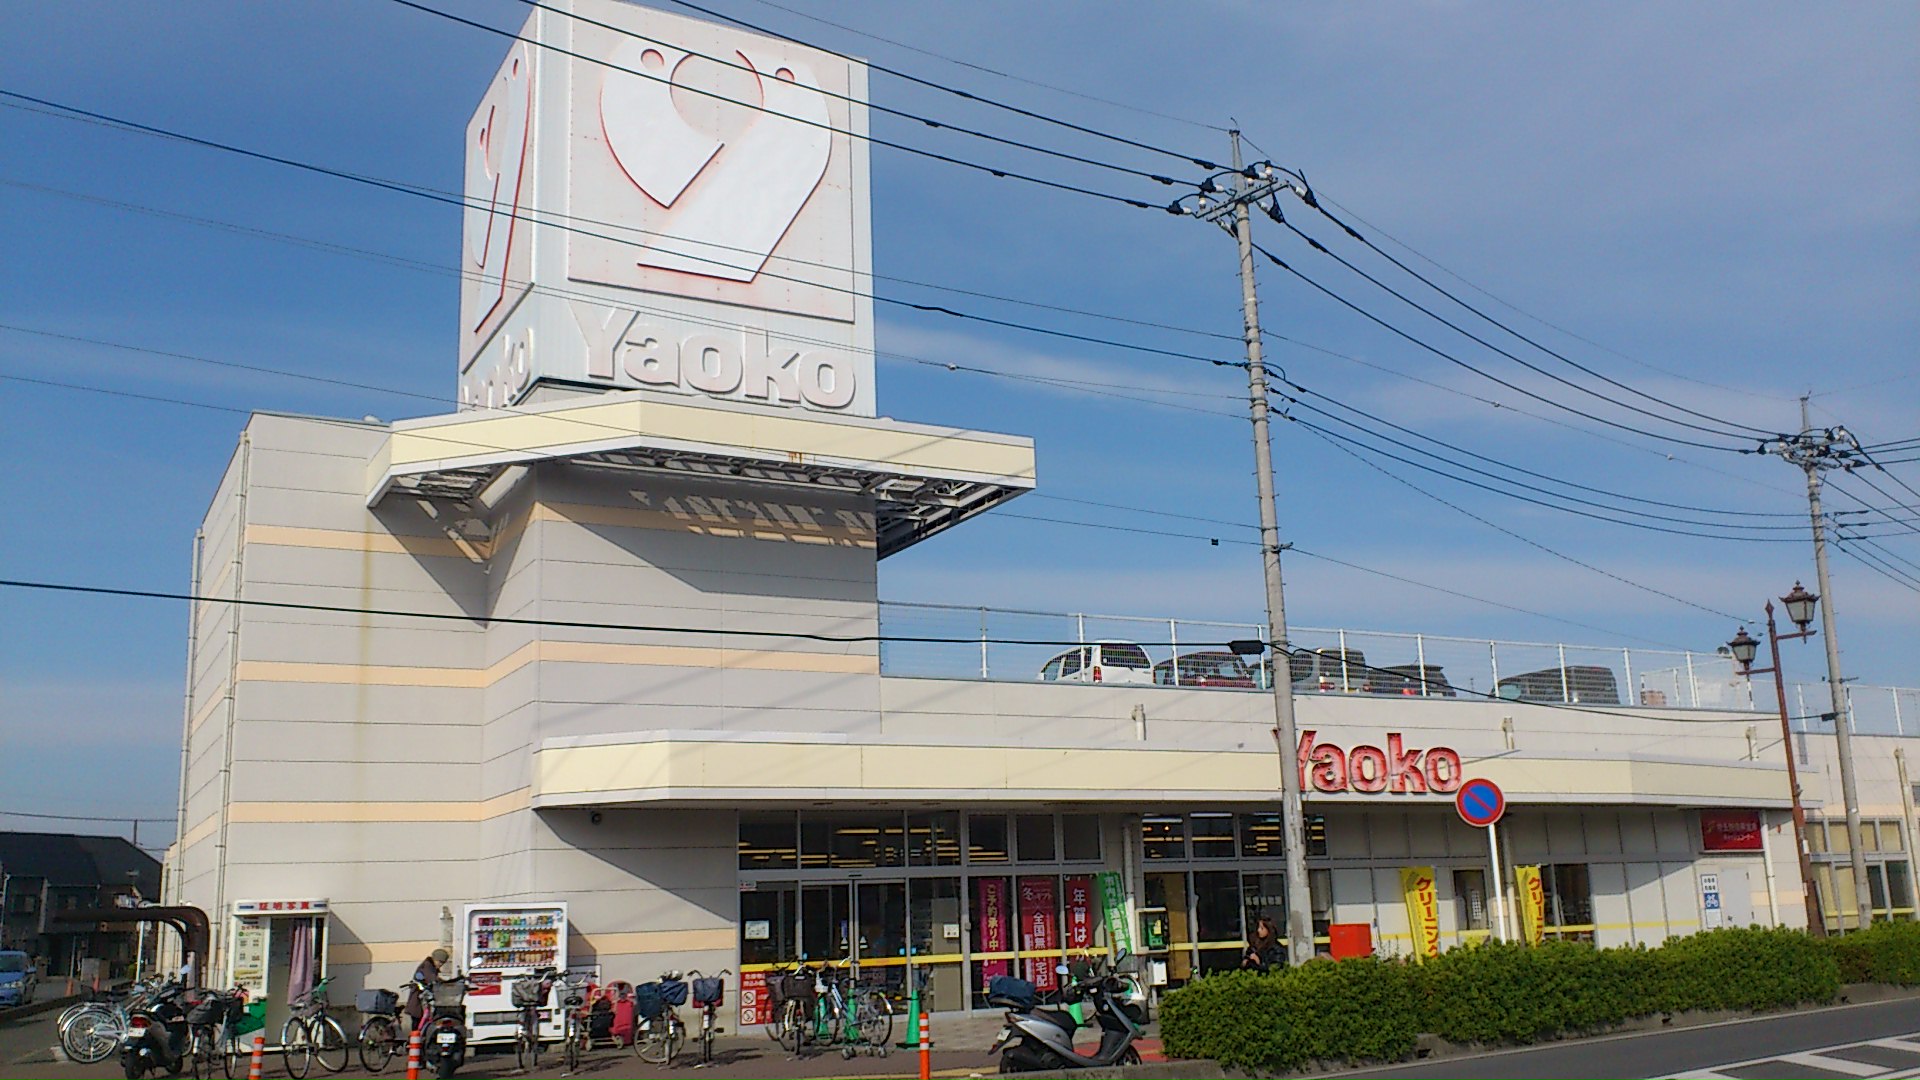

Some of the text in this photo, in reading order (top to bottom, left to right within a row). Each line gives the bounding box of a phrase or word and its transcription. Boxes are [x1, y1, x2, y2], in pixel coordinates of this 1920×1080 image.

[569, 299, 857, 410] Yaoko
[1271, 730, 1463, 794] Yaoko
[987, 884, 999, 964] ご予約承り中
[1528, 877, 1543, 947] クリーニン
